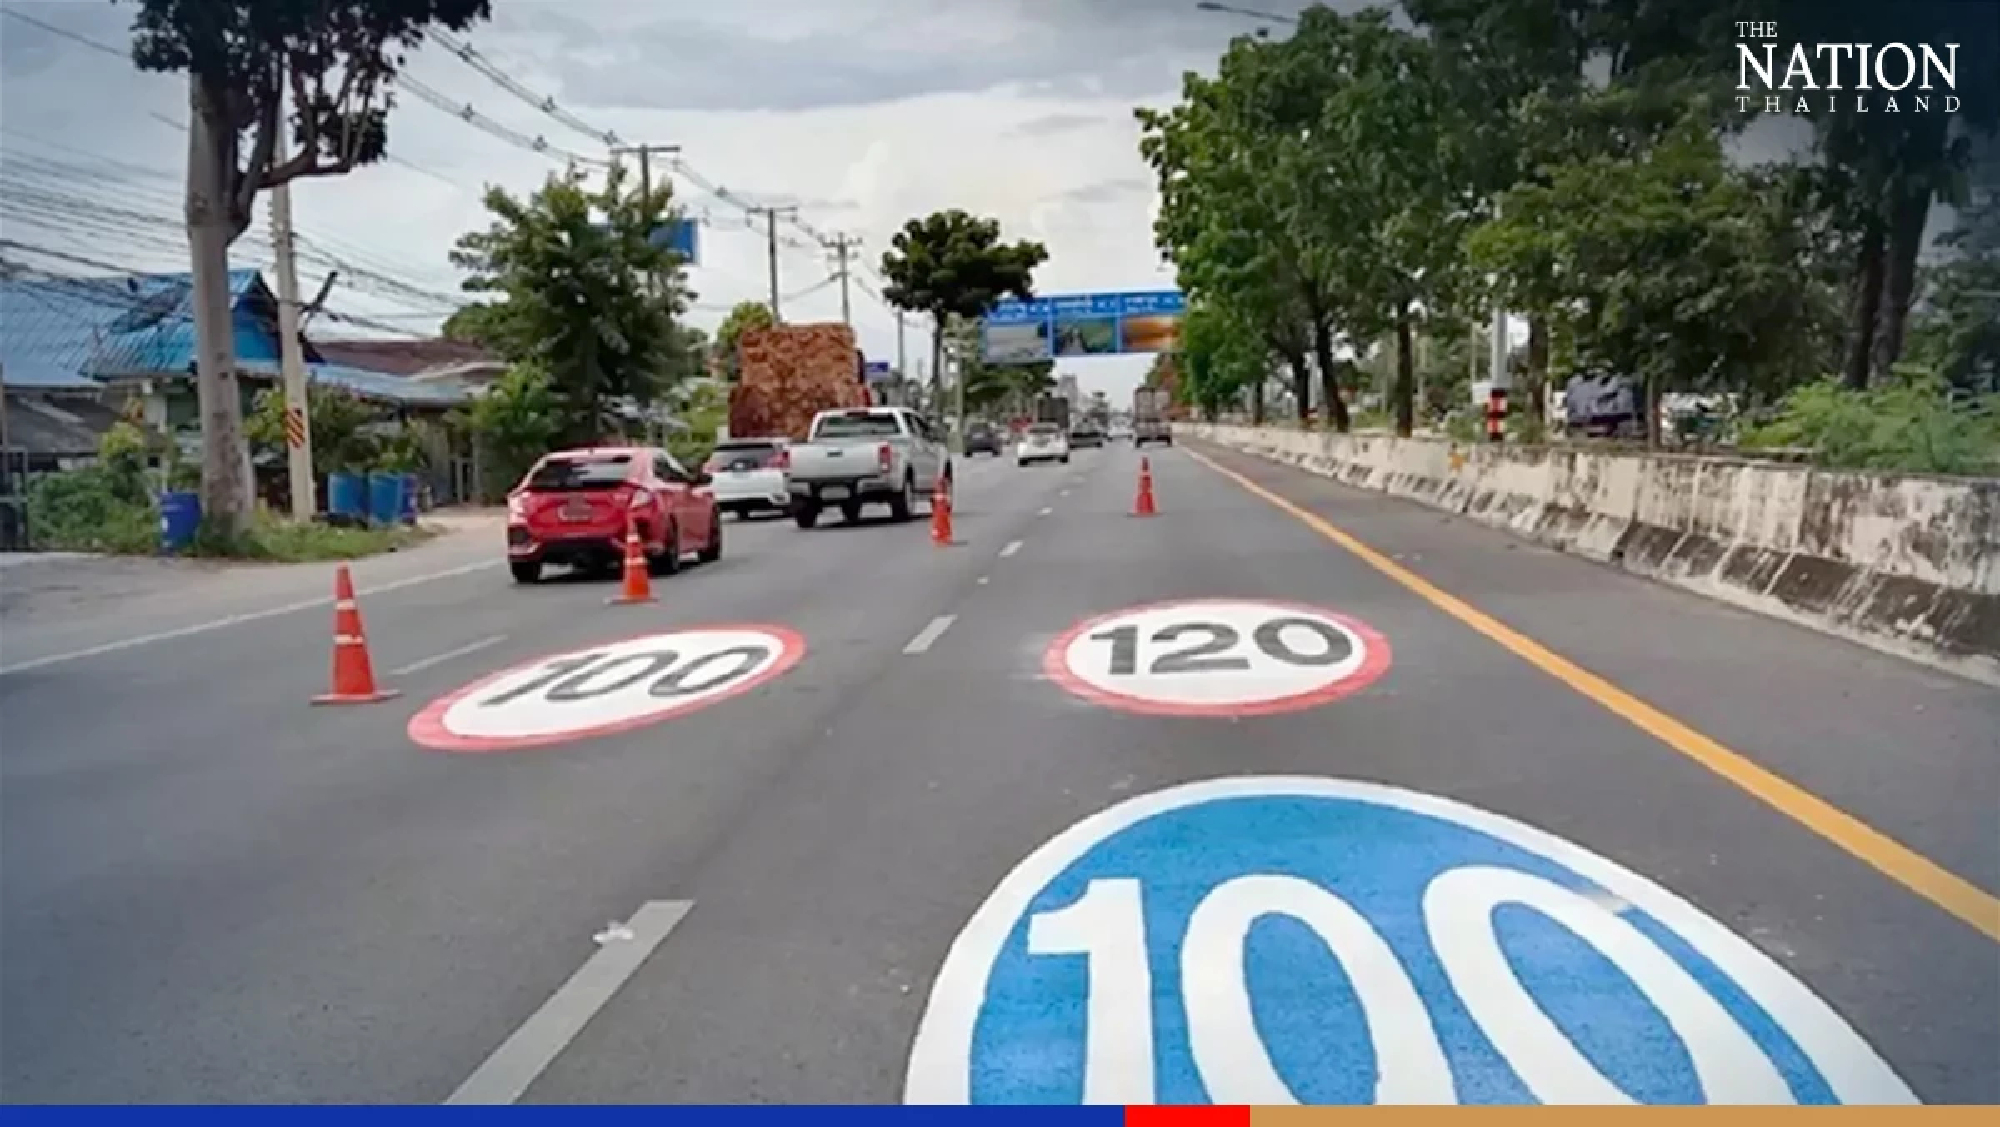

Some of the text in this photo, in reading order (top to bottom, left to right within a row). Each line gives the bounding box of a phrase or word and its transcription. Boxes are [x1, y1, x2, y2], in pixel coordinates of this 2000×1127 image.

[480, 646, 771, 707] 100
[1090, 617, 1354, 676] 120
[1027, 865, 1798, 1105] 100
